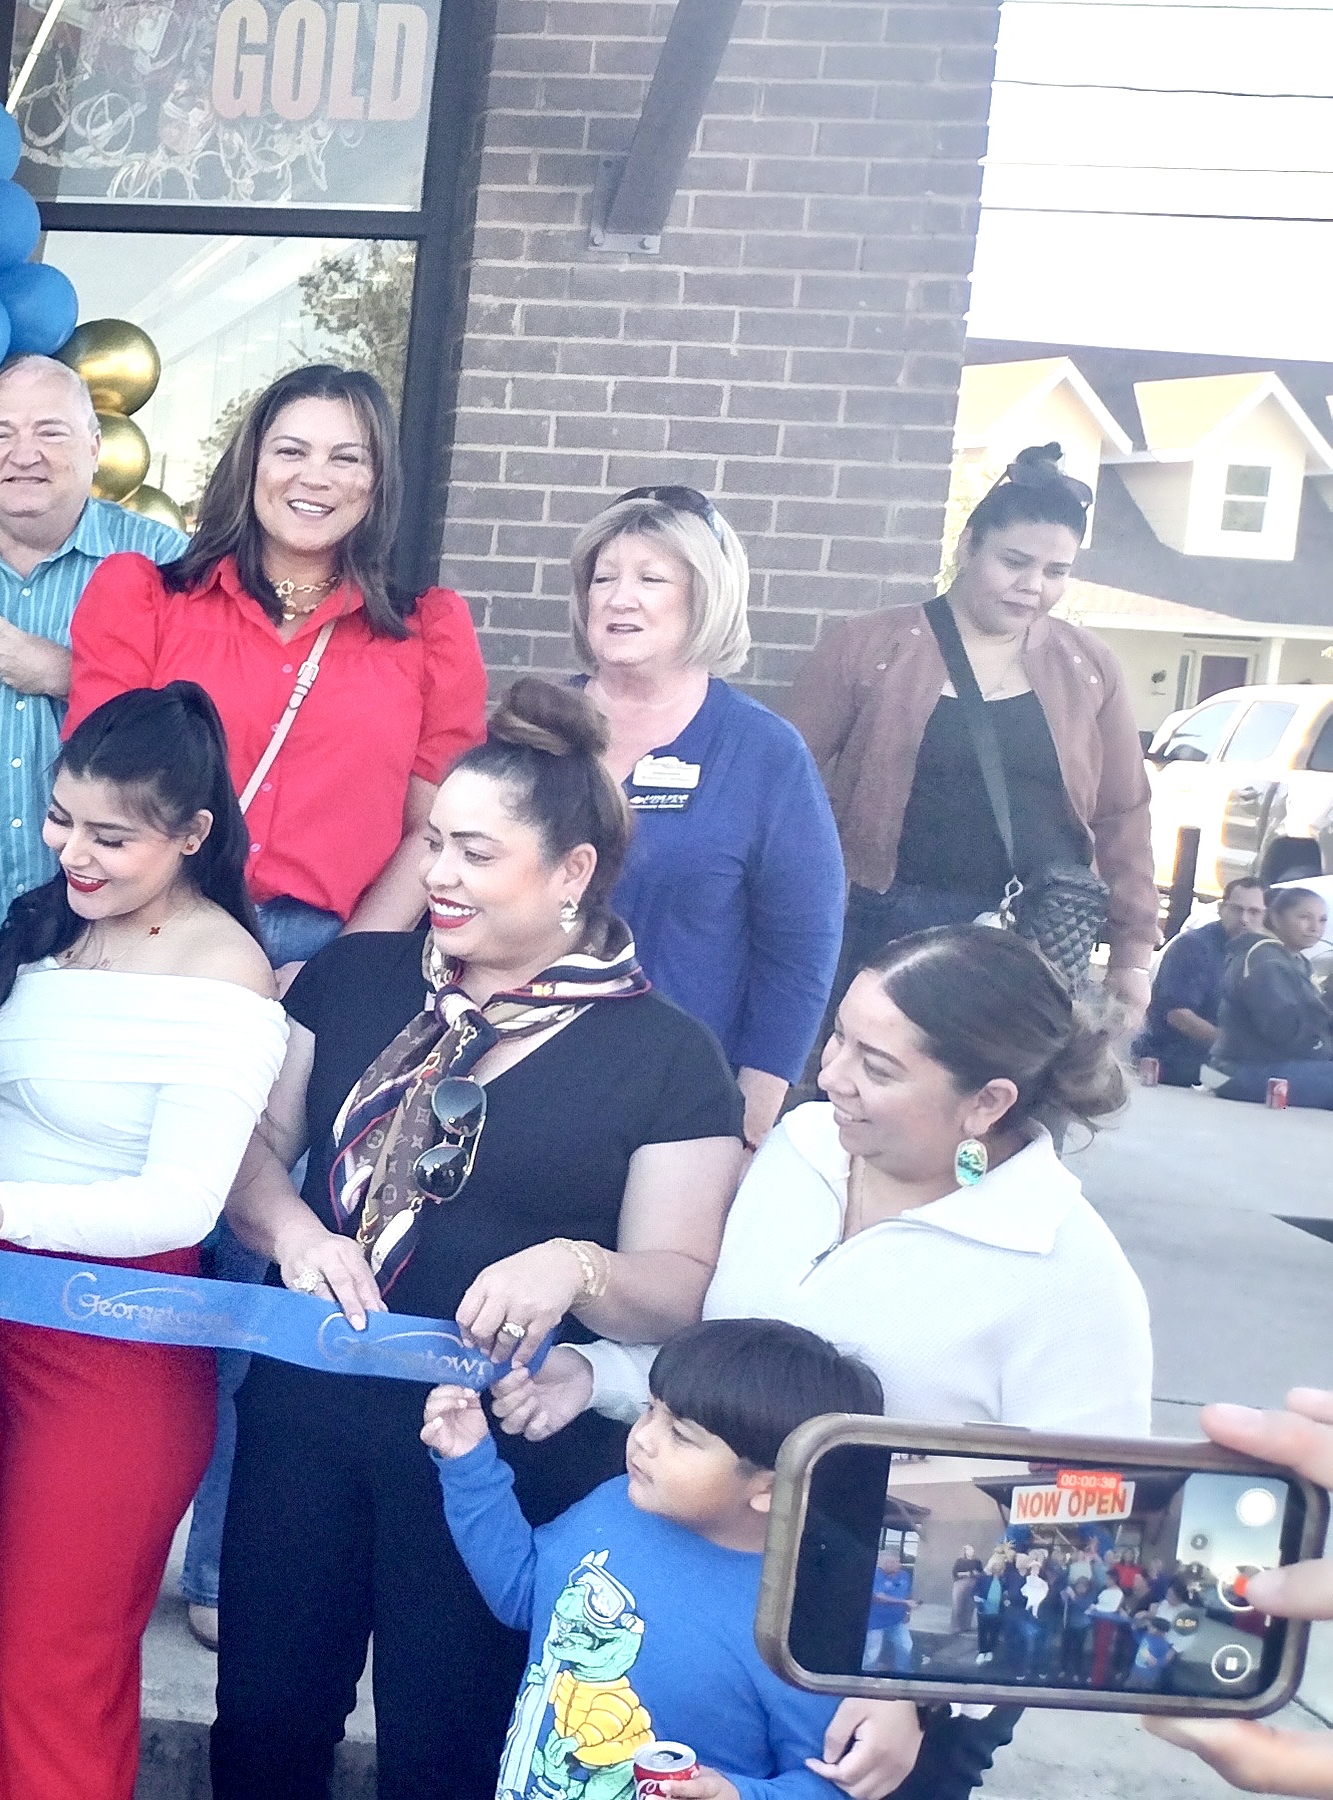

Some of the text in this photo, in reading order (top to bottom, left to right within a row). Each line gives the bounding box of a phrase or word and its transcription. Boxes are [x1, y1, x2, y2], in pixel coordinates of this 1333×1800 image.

[211, 0, 429, 121] GOLD
[1017, 1488, 1127, 1518] NOW OPEN
